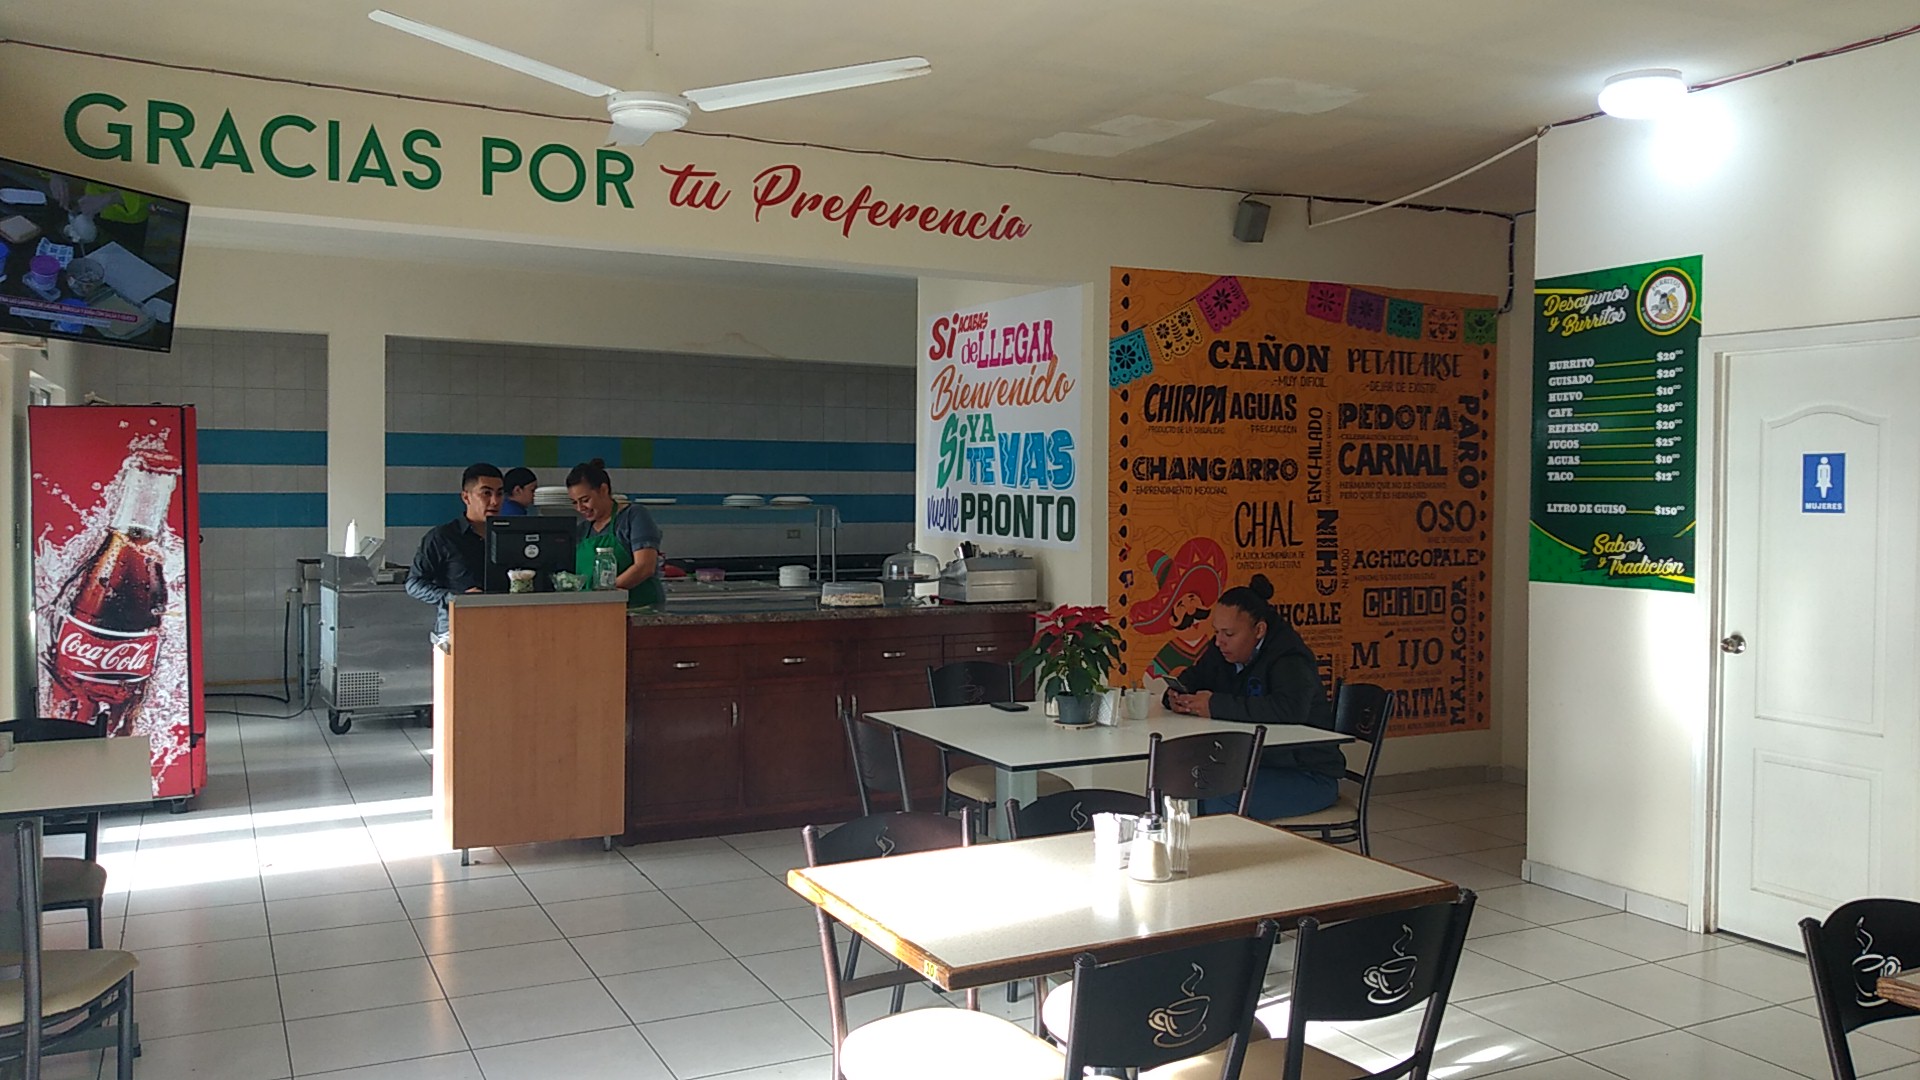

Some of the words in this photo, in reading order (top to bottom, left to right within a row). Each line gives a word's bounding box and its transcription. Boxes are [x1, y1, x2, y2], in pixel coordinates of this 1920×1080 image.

[64, 93, 442, 190] GRACIAS
[481, 137, 635, 208] POR
[659, 164, 731, 210] tu
[752, 164, 1032, 240] Preferencia
[1543, 284, 1630, 316] Desayunos
[929, 313, 959, 361] Si
[958, 311, 988, 334] ACABAS
[1548, 316, 1560, 332] y
[1561, 305, 1626, 336] Burritos
[961, 338, 978, 364] de
[977, 320, 1054, 368] LLEGAR
[1208, 335, 1331, 373] CAÑON
[1347, 348, 1463, 381] PETATEARSE
[1548, 358, 1595, 371] BURRITO
[1548, 374, 1593, 386] GUISADO
[930, 354, 1075, 421] Bienvenido
[1144, 383, 1228, 424] CHIRIPA
[1548, 391, 1583, 402] HUEVO
[1229, 392, 1297, 421] AGUAS
[1338, 403, 1453, 431] PEDOTA
[1548, 408, 1573, 417] CAFE
[1458, 395, 1480, 489] PARO
[1548, 423, 1599, 433] REFRESCO
[937, 413, 967, 488] Si
[967, 413, 995, 442] YA
[967, 447, 996, 485] TE
[998, 430, 1075, 490] VAS
[1307, 407, 1323, 503] ENCHILADO
[1338, 442, 1448, 476] CARNAL
[1547, 440, 1579, 449] JUGOS
[1547, 456, 1580, 465] AGUAS
[1132, 456, 1298, 481] CHANGARRO
[1547, 472, 1574, 481] TACO
[927, 487, 959, 532] vuelve
[961, 492, 1076, 542] PRONTO
[1416, 500, 1476, 532] OSO
[1547, 503, 1577, 513] LITRO
[1579, 504, 1592, 514] DE
[1594, 504, 1626, 514] GUISO
[1805, 502, 1843, 510] MUJERES
[1234, 500, 1304, 548] CHAL
[1316, 509, 1339, 596] CHIN
[1352, 548, 1479, 569] ACHICOPALE
[1592, 533, 1645, 555] Sabor
[1342, 548, 1350, 576] MODO
[1598, 557, 1607, 568] y
[1608, 554, 1685, 576] Tradición
[60, 632, 151, 672] Coca-Cola
[1450, 576, 1467, 725] MALACOPA
[1386, 687, 1447, 719] RITA
